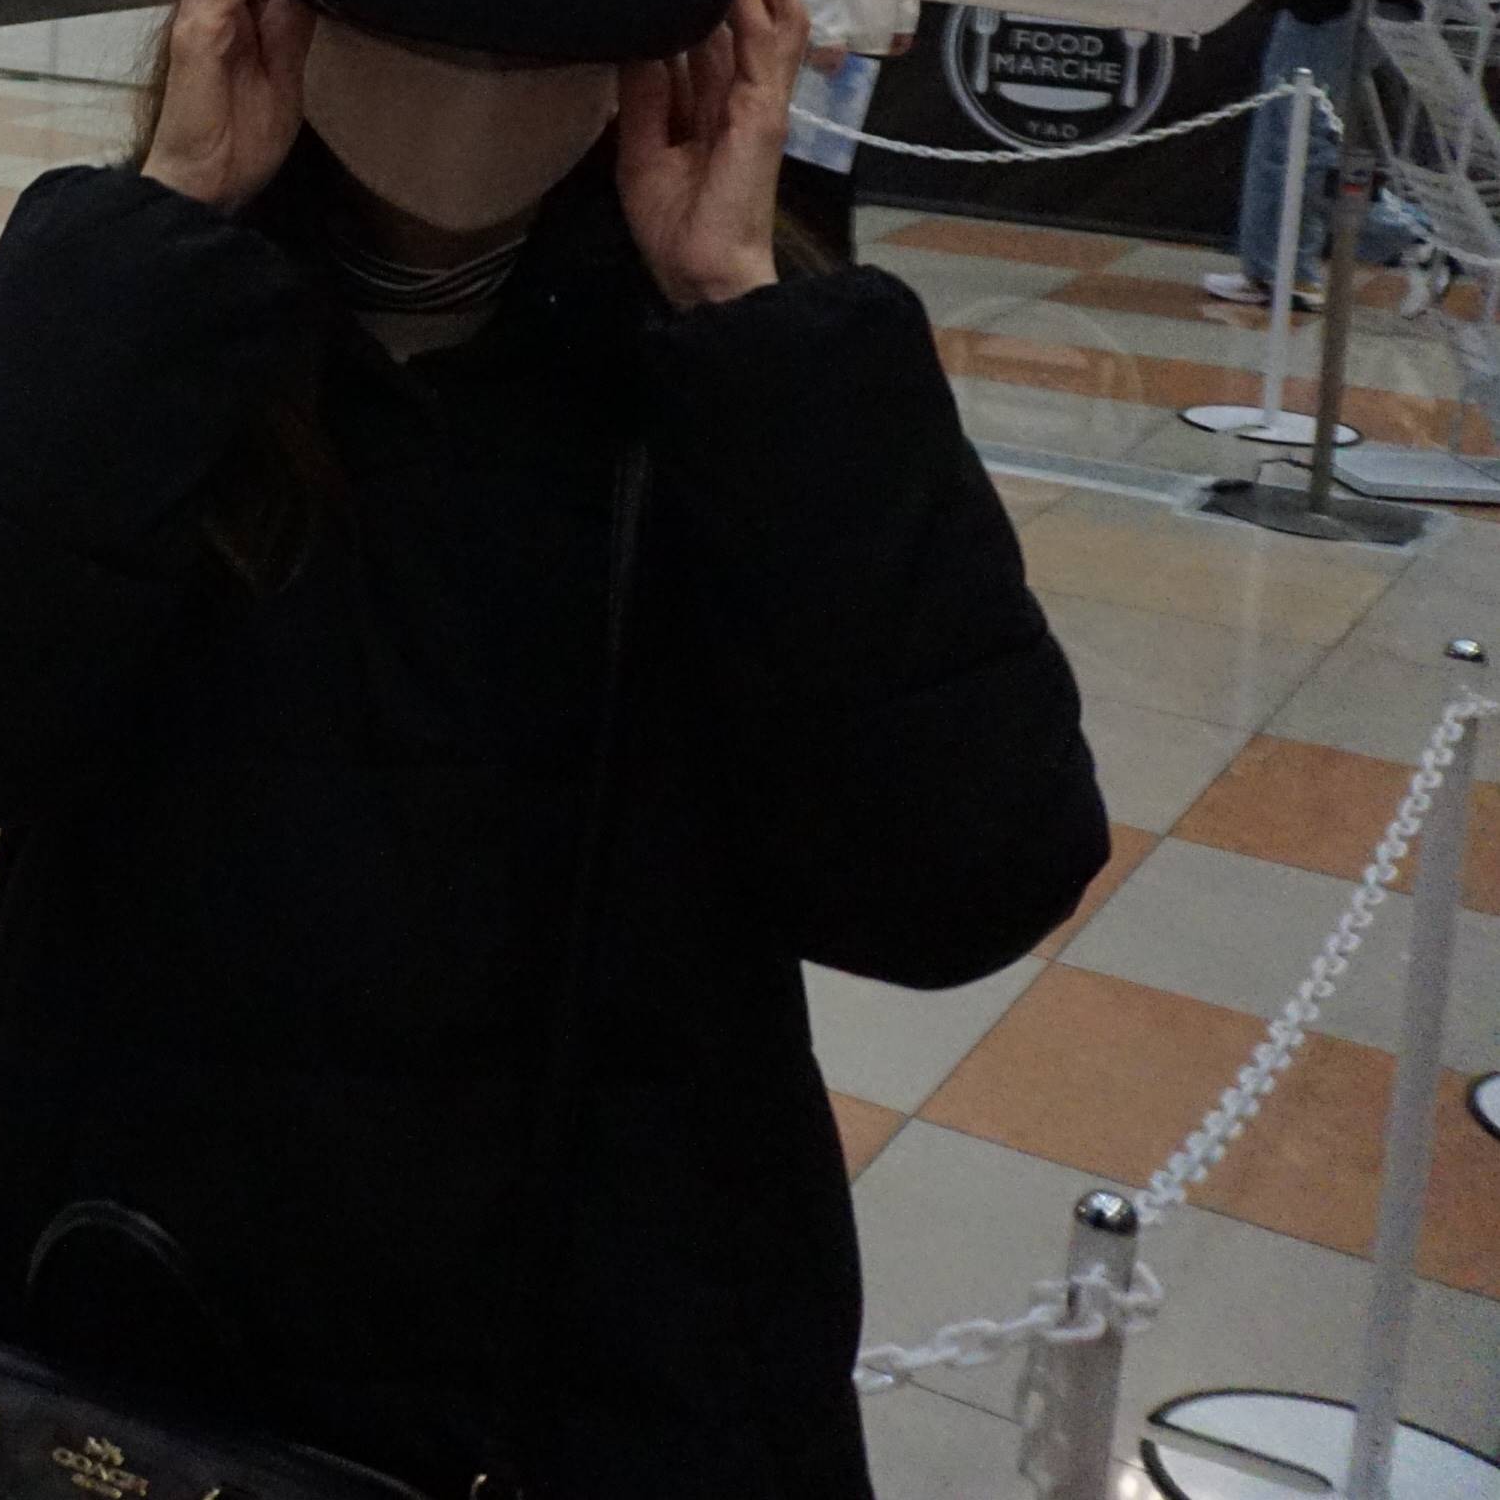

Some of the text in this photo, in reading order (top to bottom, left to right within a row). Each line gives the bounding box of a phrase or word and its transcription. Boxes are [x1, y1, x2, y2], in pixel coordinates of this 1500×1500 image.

[1013, 29, 1104, 56] FOOD
[993, 54, 1122, 83] MARCHE
[1028, 121, 1079, 139] YAO
